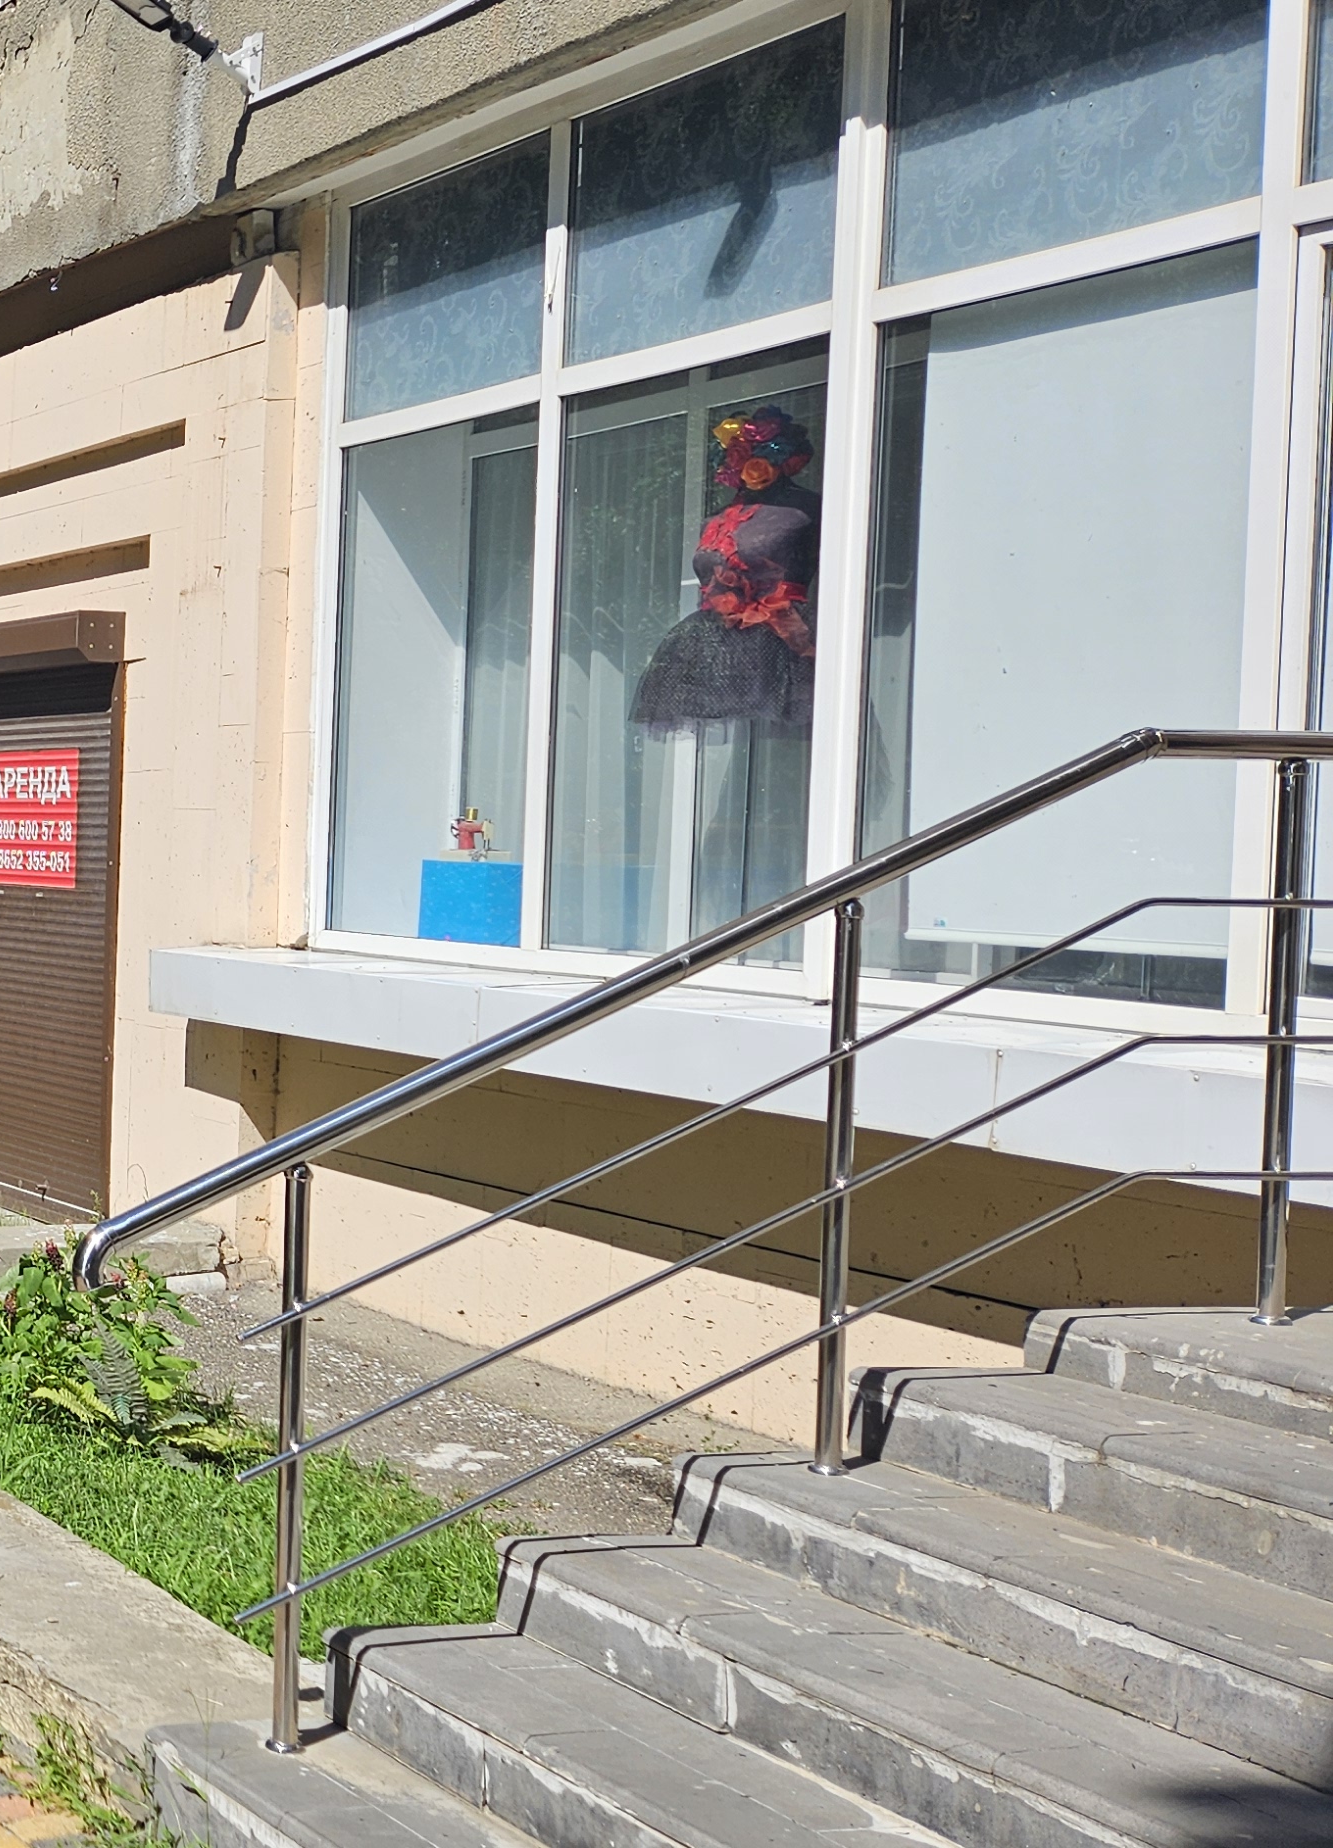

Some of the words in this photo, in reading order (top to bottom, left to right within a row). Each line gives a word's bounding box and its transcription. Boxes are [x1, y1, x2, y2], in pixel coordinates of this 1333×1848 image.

[18, 820, 39, 841] 600
[41, 821, 55, 841] 57
[58, 821, 72, 841] 38
[25, 850, 70, 873] 355-051
